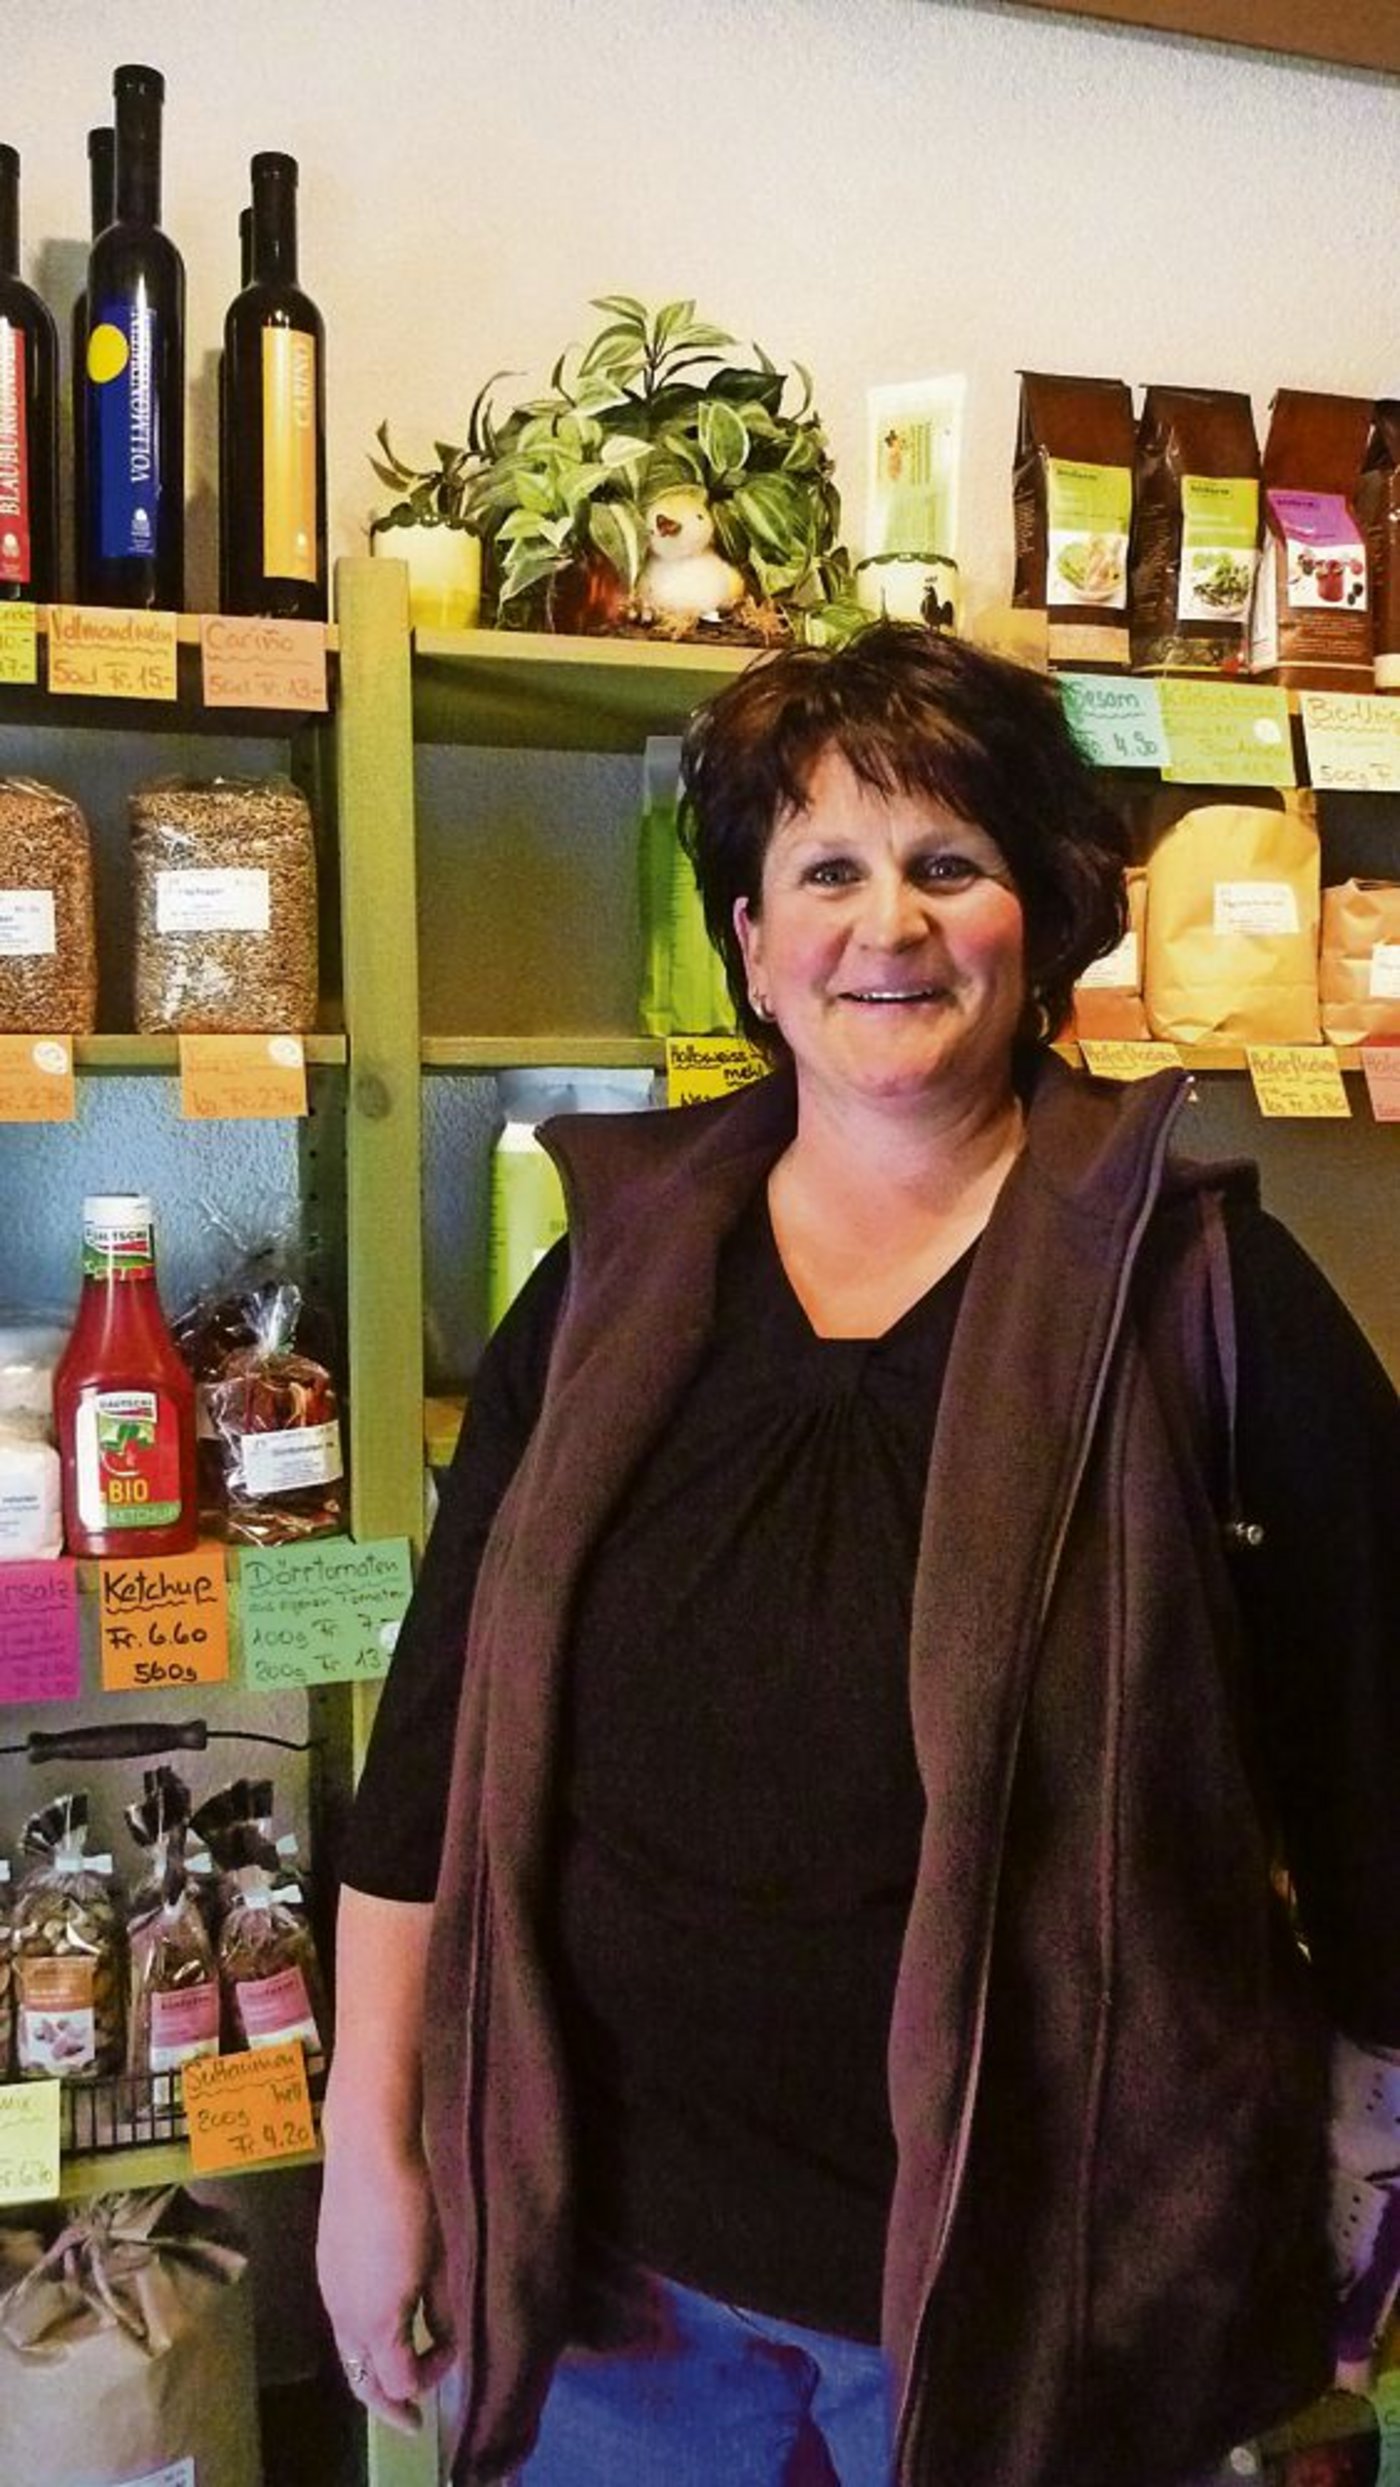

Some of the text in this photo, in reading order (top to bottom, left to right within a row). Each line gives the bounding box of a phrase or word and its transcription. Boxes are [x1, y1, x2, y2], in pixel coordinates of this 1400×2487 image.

[108, 1479, 149, 1504] BIO
[245, 1554, 399, 1590] Dörrtomaten
[104, 1571, 212, 1605] Ketchup
[148, 1623, 207, 1645] 6.60
[252, 1628, 308, 1650] 100g
[134, 1662, 197, 1682] 560g
[255, 1660, 307, 1682] 200g
[262, 2121, 309, 2149] 4.20
